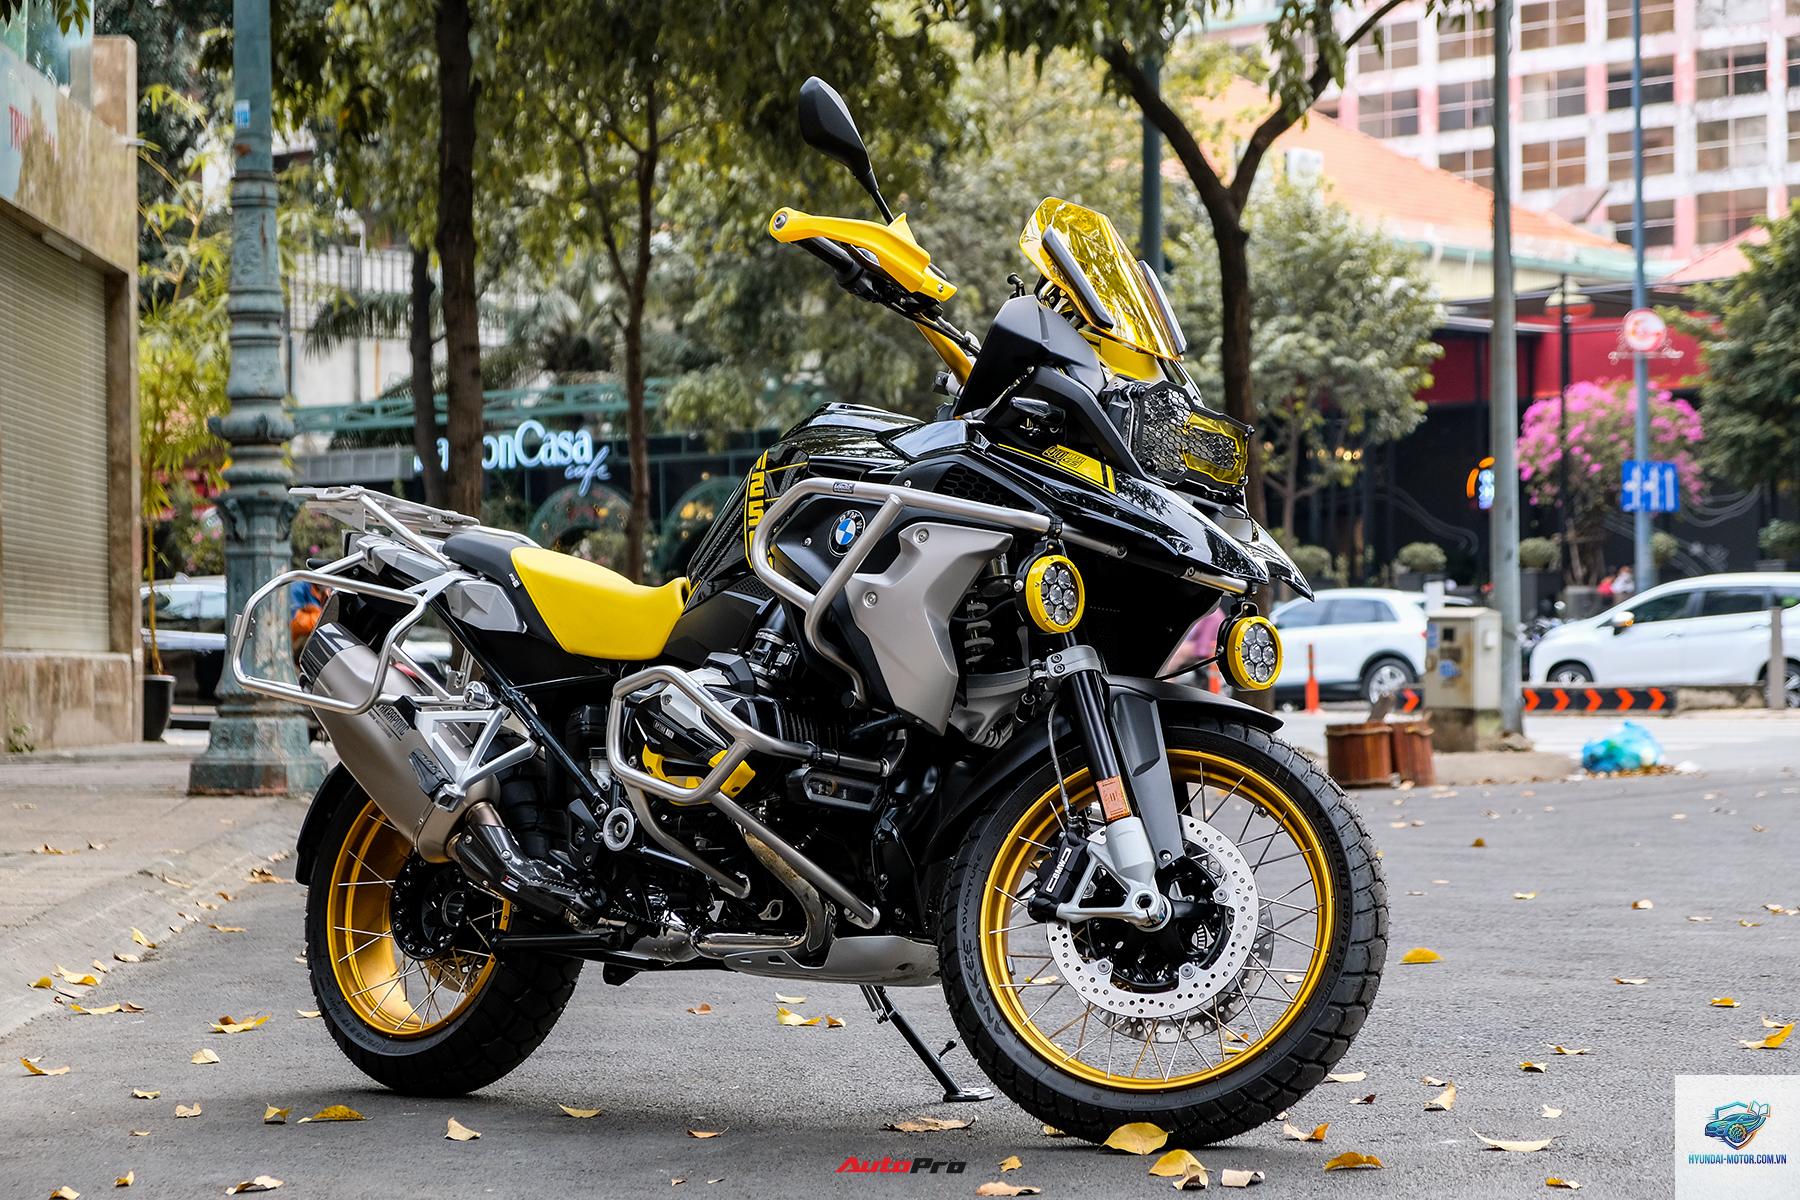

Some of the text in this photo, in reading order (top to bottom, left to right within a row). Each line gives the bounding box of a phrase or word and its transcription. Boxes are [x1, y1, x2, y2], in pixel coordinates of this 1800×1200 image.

[1053, 859, 1065, 878] BMW
[962, 853, 1005, 1035] ANAKEE ADVENTURE
